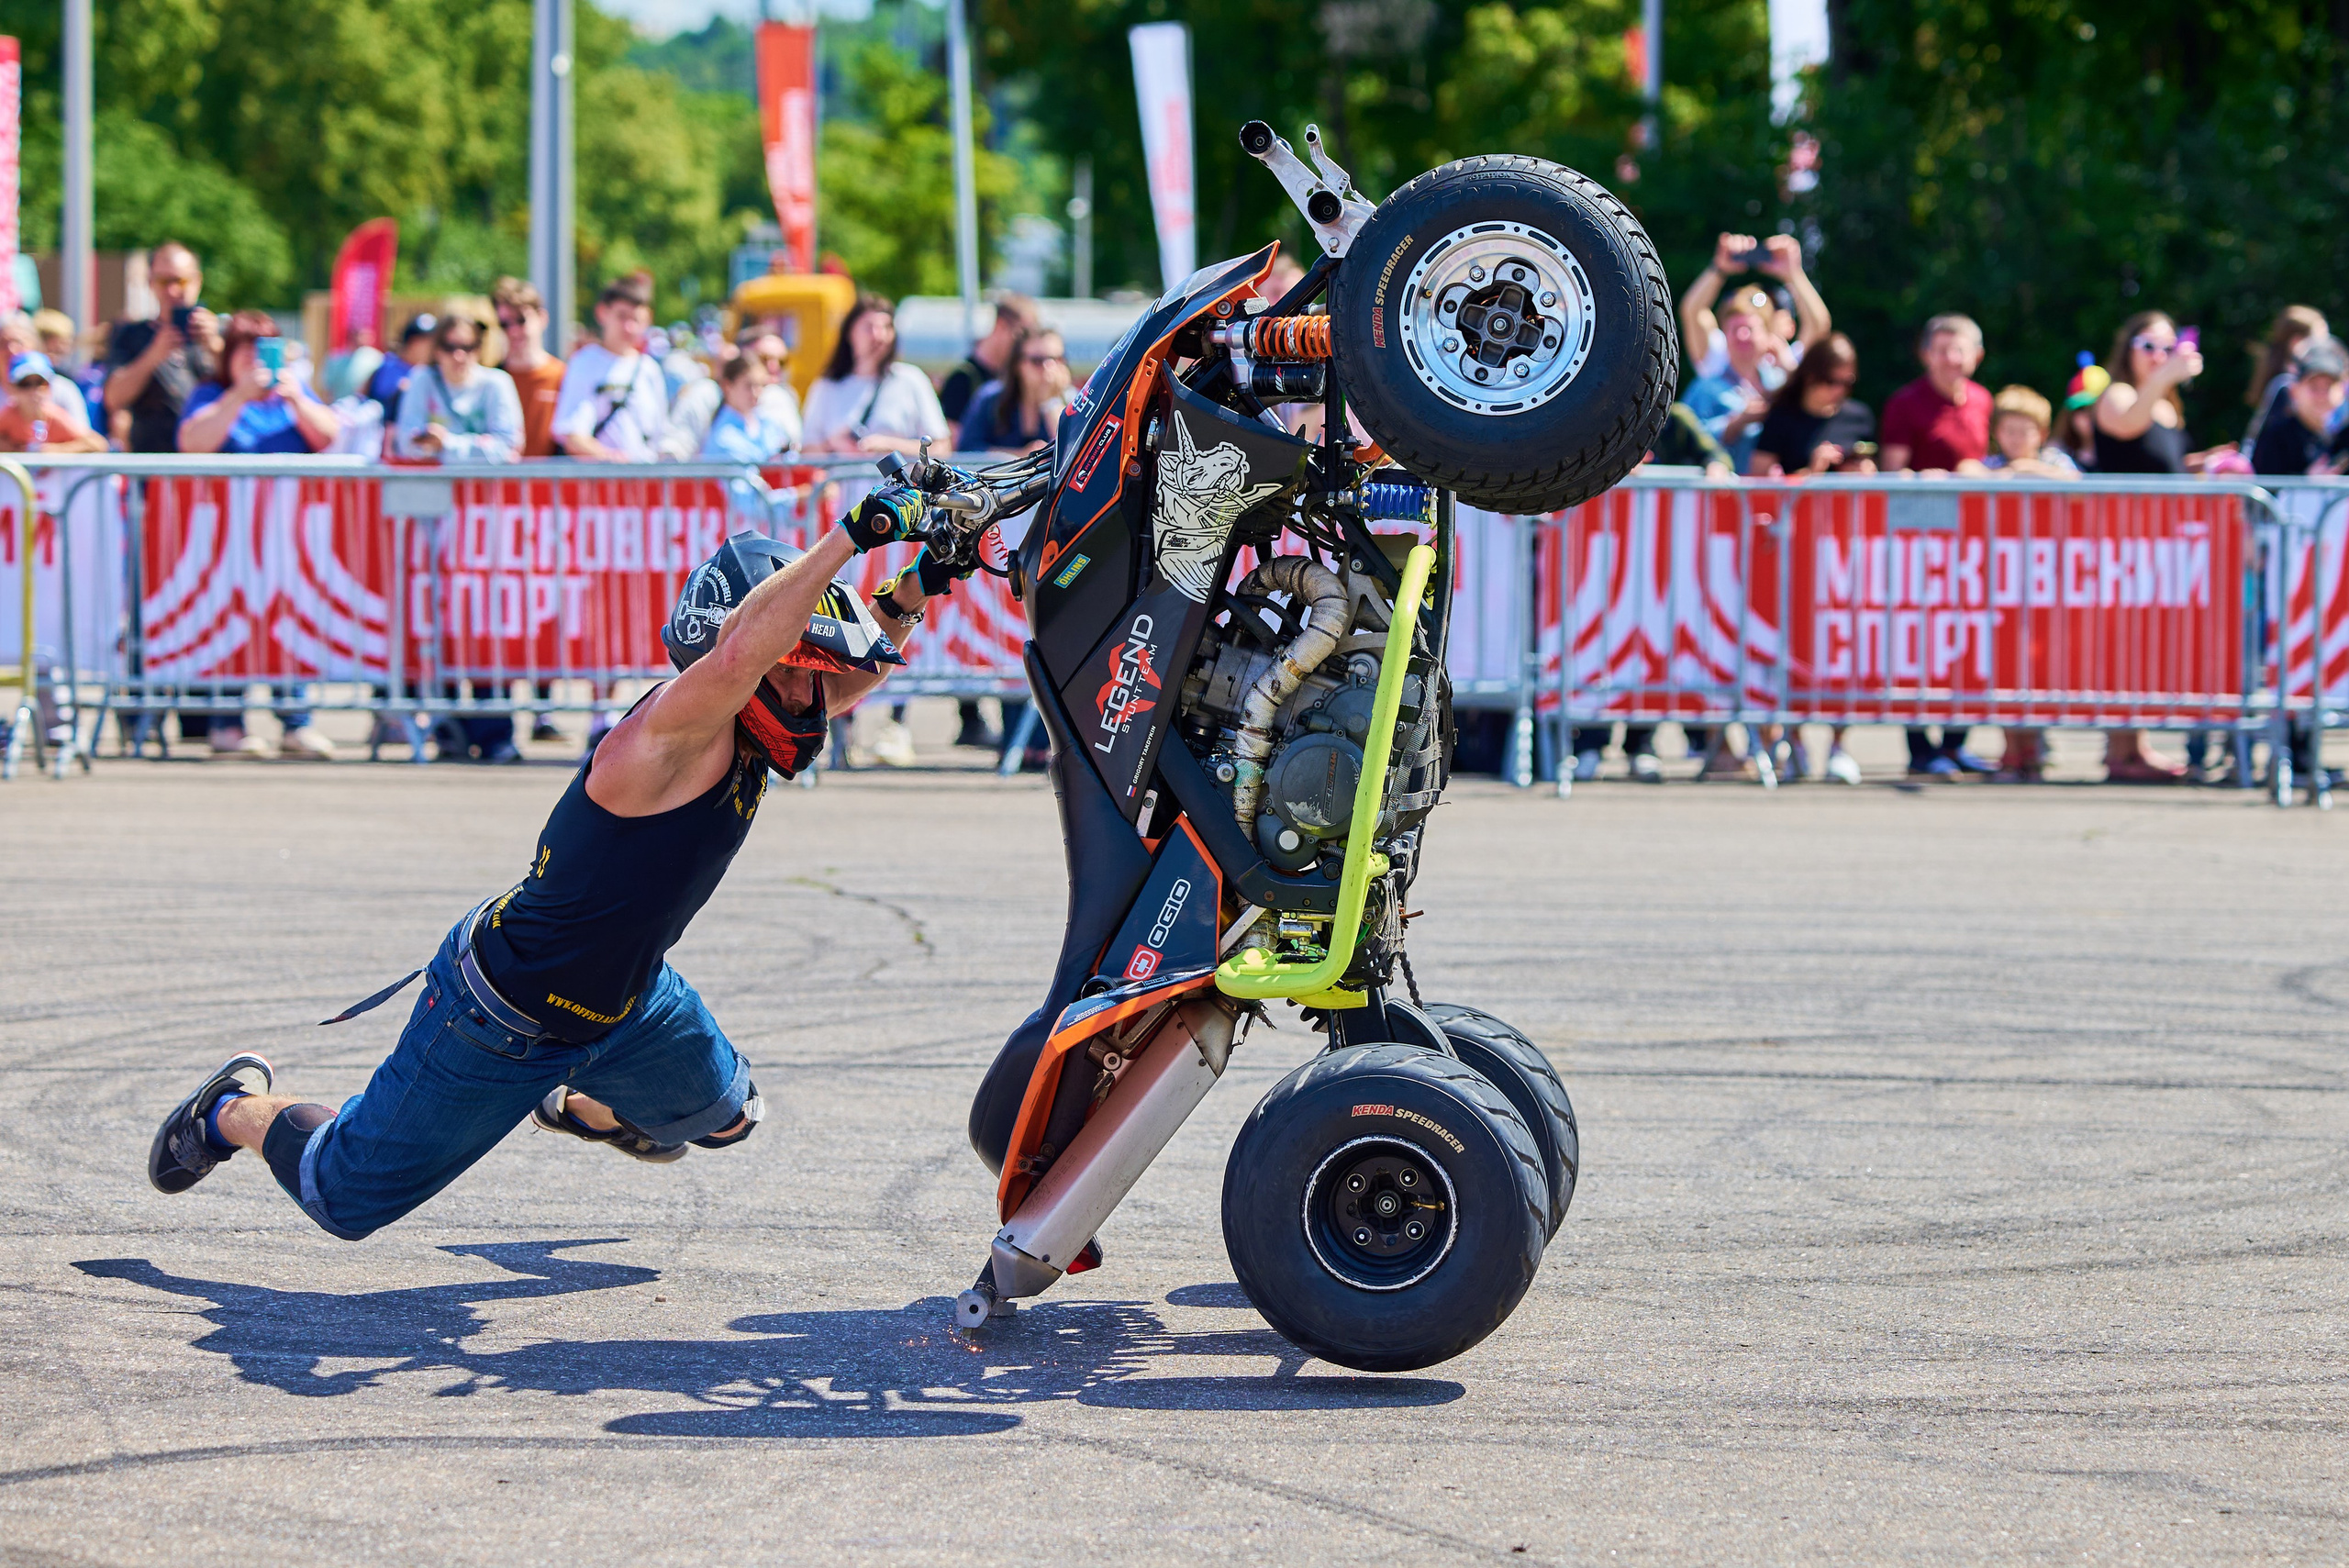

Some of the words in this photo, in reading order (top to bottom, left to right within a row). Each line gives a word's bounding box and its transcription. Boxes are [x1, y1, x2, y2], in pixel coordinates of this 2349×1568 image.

[1375, 234, 1414, 306] SPEEDRACER
[1373, 306, 1386, 348] KENDA
[1814, 521, 2210, 608] МОСКОВСКИЙ
[412, 573, 590, 639] СПОРТ
[811, 623, 836, 638] HEAD
[1813, 608, 2004, 682] СПОРТ
[1094, 614, 1154, 754] LEGEND
[1121, 684, 1144, 734] STUNT
[1137, 644, 1158, 683] TEAM
[1132, 756, 1145, 784] GRIGORY
[1147, 878, 1191, 949] OGIO
[1352, 1105, 1394, 1117] KENDA
[1395, 1108, 1465, 1154] SPEEDRACER
